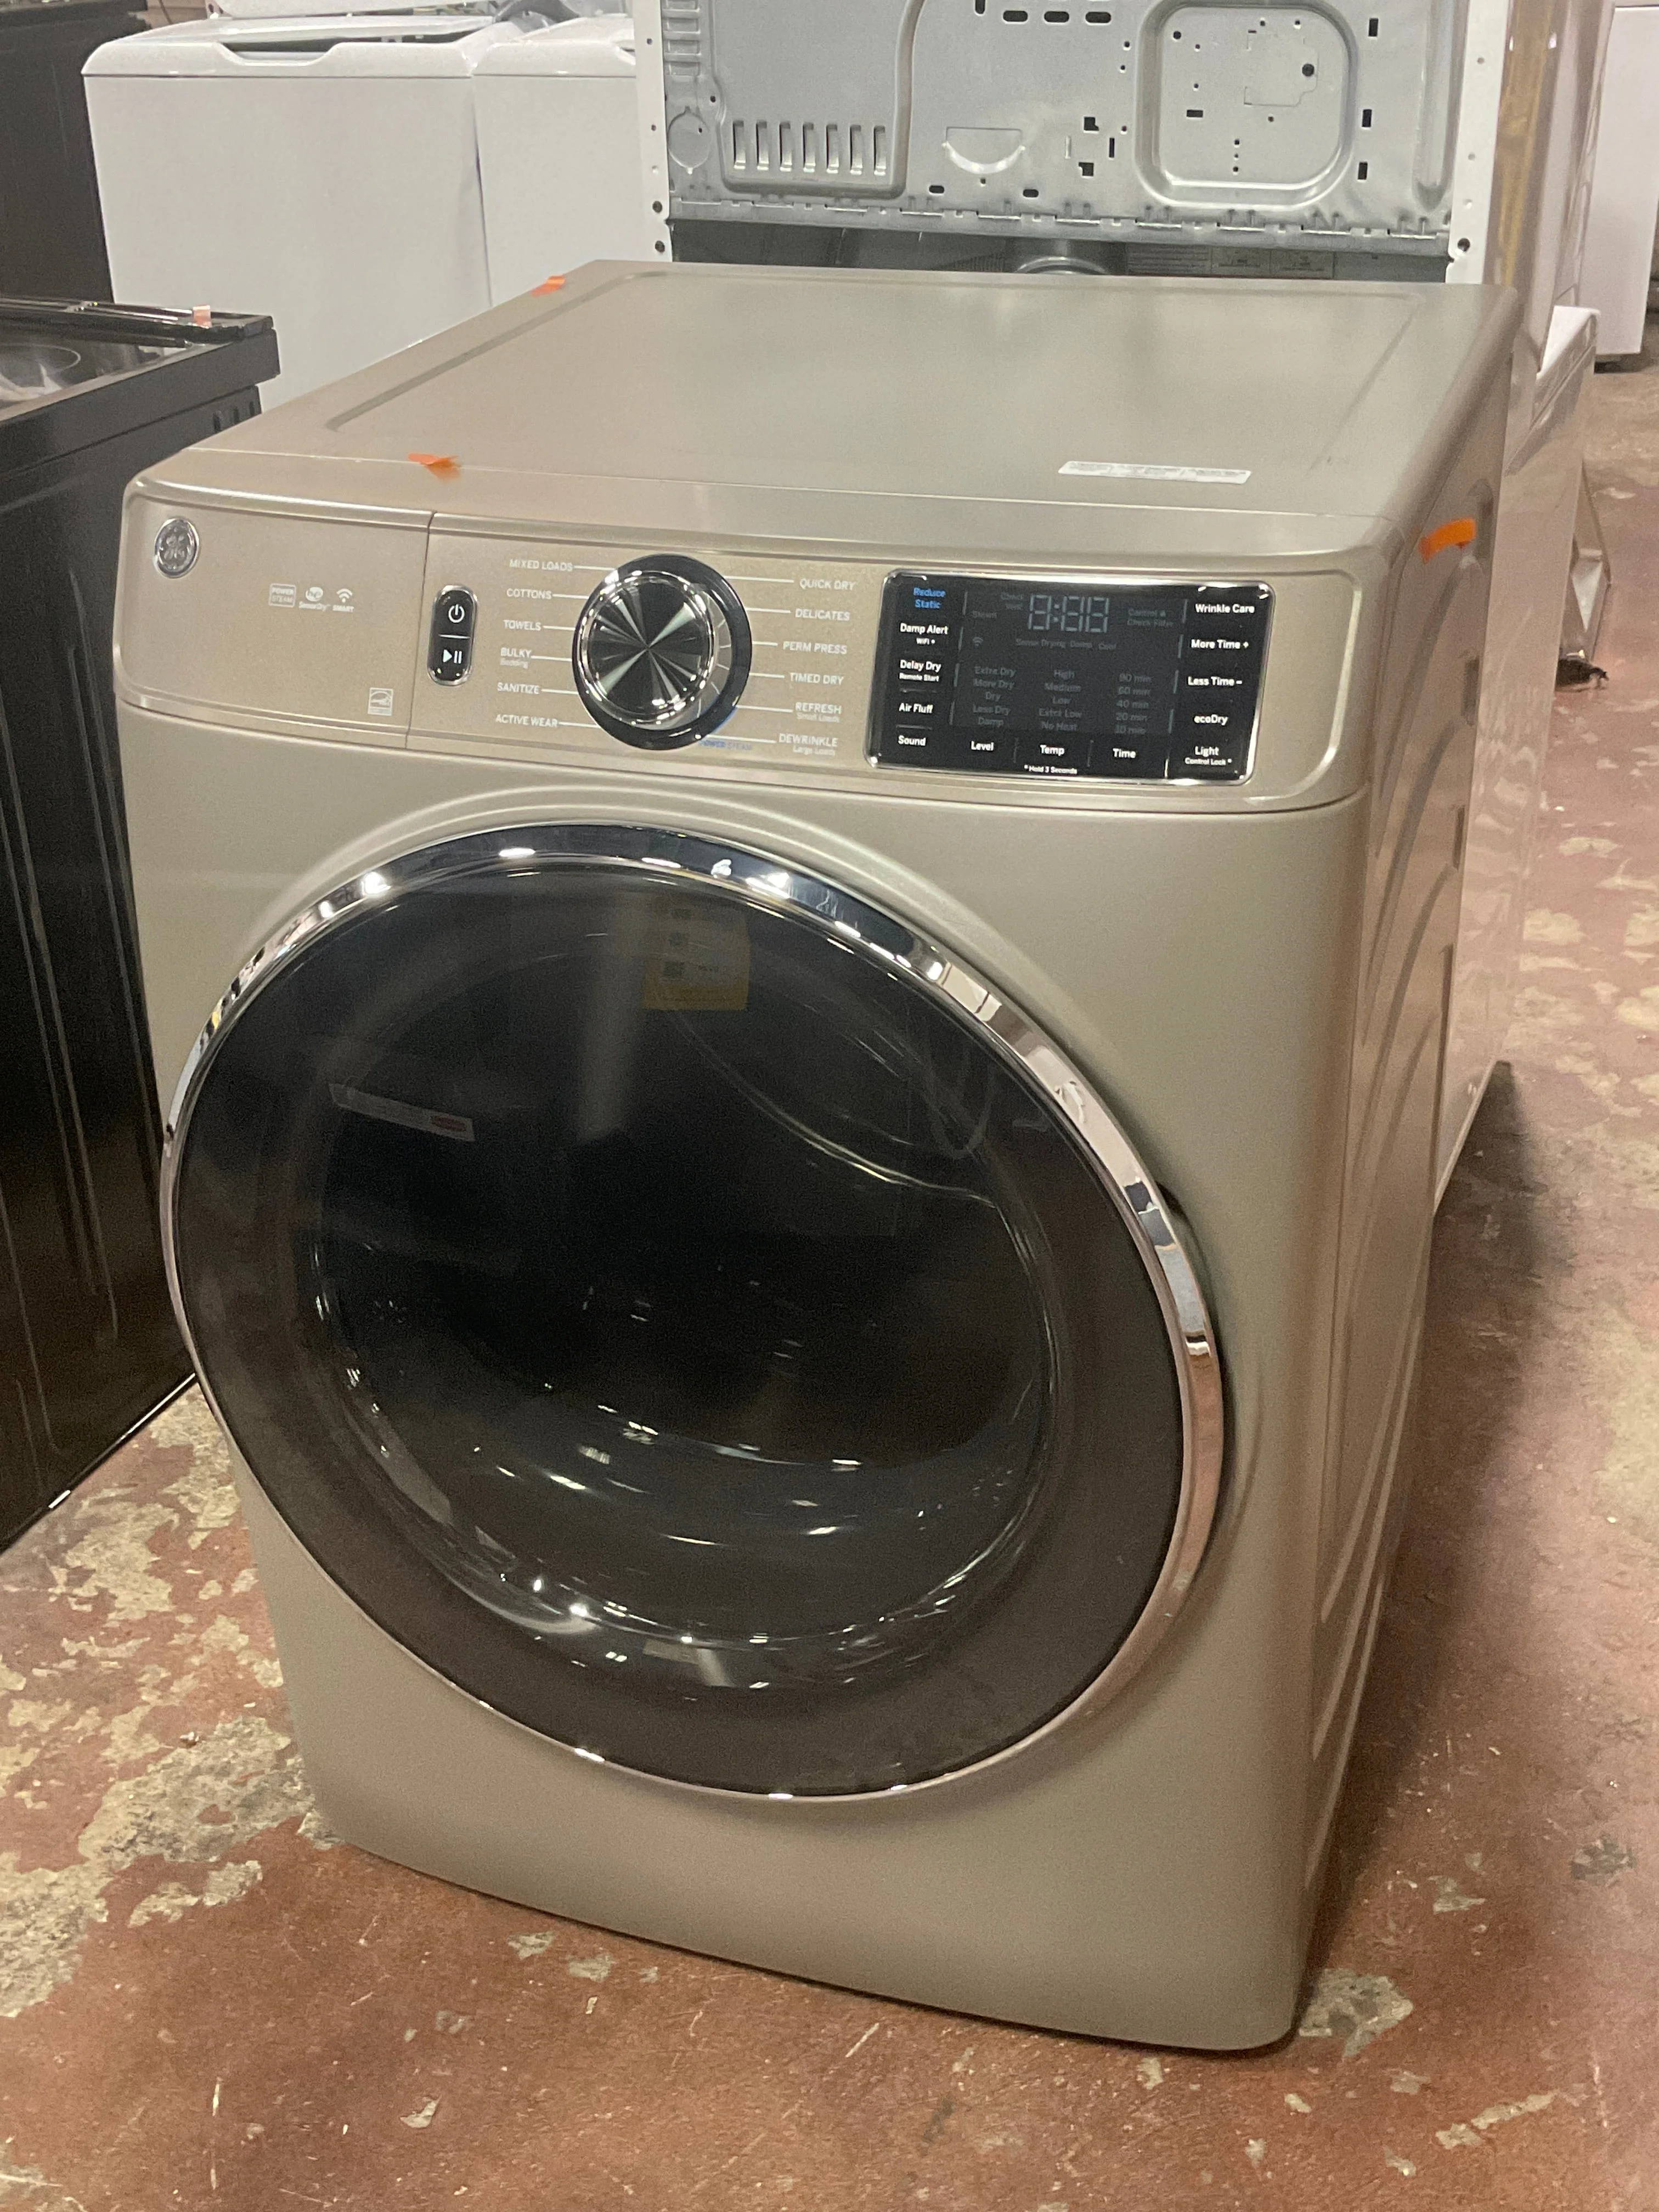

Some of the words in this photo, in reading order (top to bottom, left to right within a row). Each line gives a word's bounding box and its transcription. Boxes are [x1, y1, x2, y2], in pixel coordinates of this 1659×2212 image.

[509, 558, 540, 569] MIXED
[541, 561, 573, 572] LOADS
[799, 578, 832, 590] QUICK
[834, 580, 856, 591] DRY
[506, 588, 552, 600] COTTONS
[913, 587, 946, 597] Reduce
[915, 599, 941, 609] Static
[1195, 603, 1231, 614] Wrinkle
[1232, 604, 1256, 614] Care
[795, 608, 851, 622] DELICATES
[503, 619, 541, 631] TOWELS
[900, 623, 926, 635] Damp
[927, 624, 949, 635] Alert
[783, 641, 812, 652] PERM
[814, 642, 848, 655] PRESS
[1190, 639, 1216, 649] More
[1217, 639, 1241, 650] Time
[500, 647, 532, 658] BULKY
[900, 659, 924, 672] Delay
[926, 661, 942, 674] Dry
[1000, 667, 1017, 678] Dry
[789, 672, 821, 684] TIMED
[822, 674, 844, 685] DRY
[899, 672, 923, 681] Remote
[923, 674, 940, 682] Start
[1188, 676, 1210, 686] Less
[1211, 676, 1235, 687] Time
[497, 682, 540, 695] SANITIZE
[998, 679, 1015, 690] Dry
[985, 691, 1001, 702] Dry
[795, 702, 842, 715] REFRESH
[899, 702, 912, 712] Air
[913, 703, 934, 714] Fluff
[1116, 699, 1130, 708] 40
[995, 705, 1011, 716] Dry
[1064, 709, 1083, 718] Low
[1115, 712, 1128, 721] 20
[495, 713, 529, 725] ACTIVE
[531, 716, 558, 727] WEAR
[978, 716, 1005, 729] Damp
[1194, 714, 1229, 726] ecoDry
[778, 732, 839, 748] DEWRINKLE
[898, 735, 927, 747] Sound
[971, 741, 995, 752] Level
[1040, 744, 1065, 757] Temp
[1194, 746, 1220, 758] Light
[1113, 748, 1137, 759] Time
[1184, 757, 1210, 766] Control
[1210, 758, 1226, 766] Lock
[1050, 766, 1078, 775] Seconds
